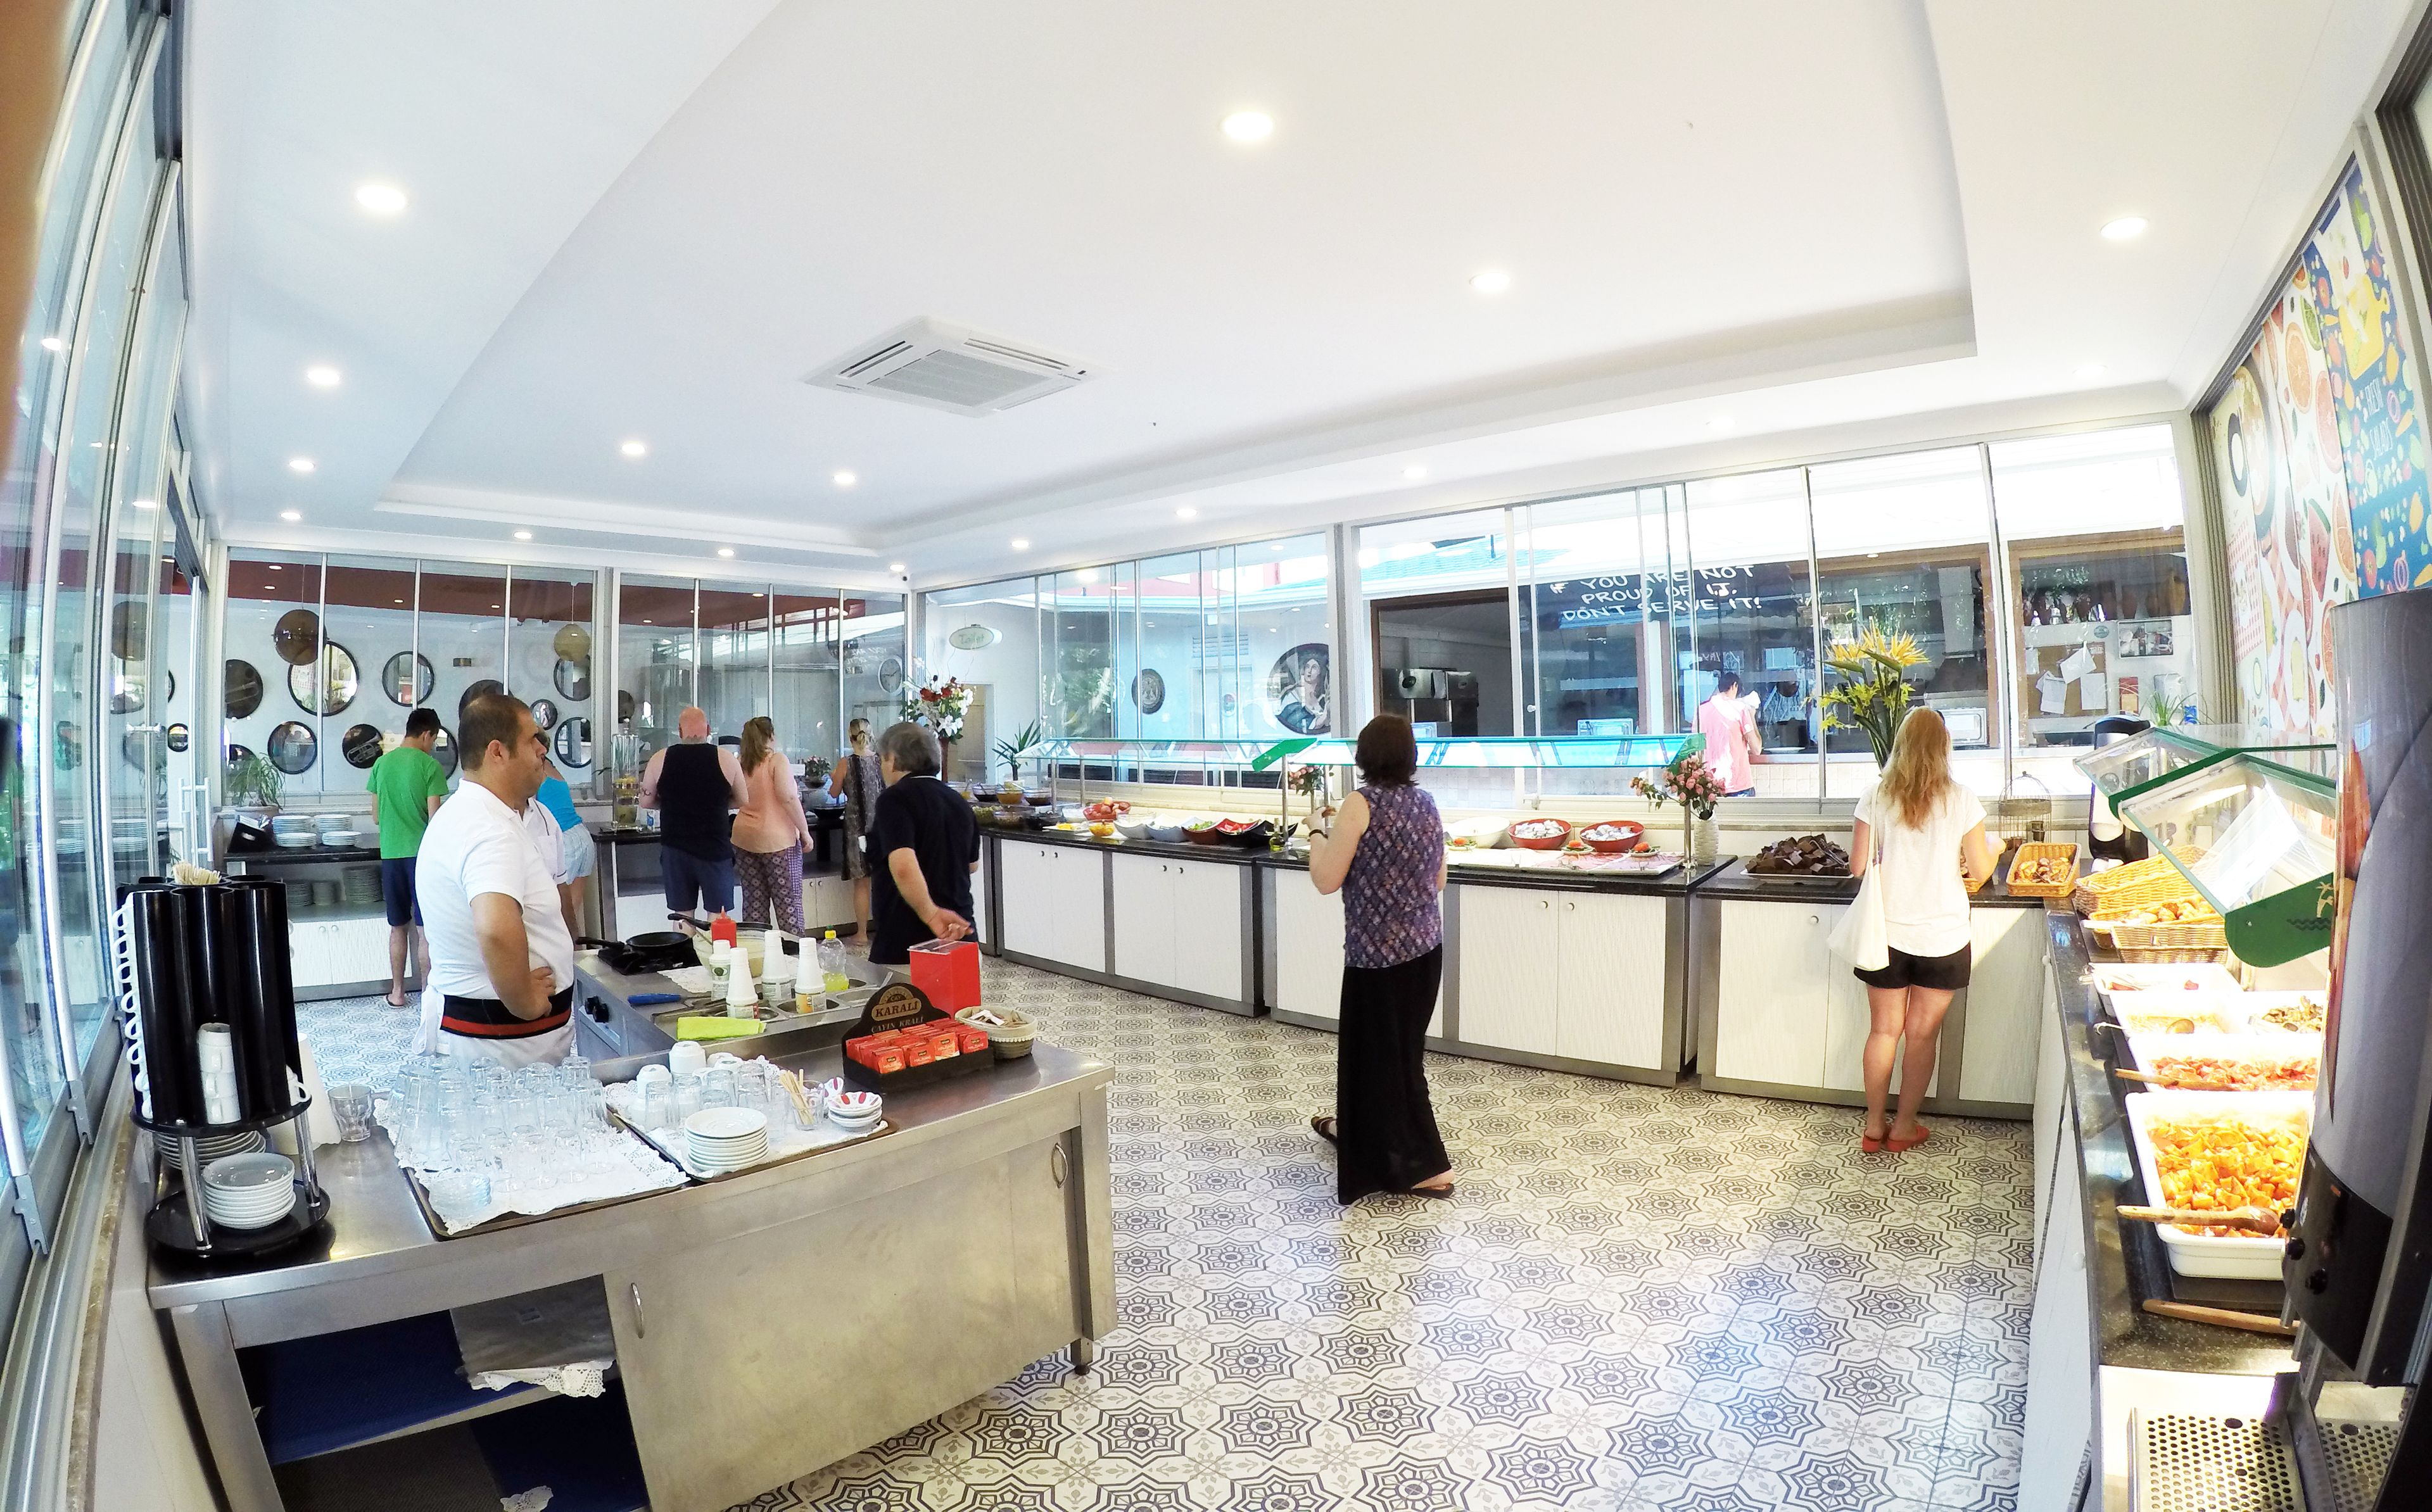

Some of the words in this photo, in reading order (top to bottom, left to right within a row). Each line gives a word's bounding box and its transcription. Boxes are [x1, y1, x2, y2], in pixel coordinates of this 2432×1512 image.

[1580, 575, 1628, 590] YOU
[1645, 570, 1689, 584] ARE
[1699, 565, 1755, 580] NOT
[1581, 588, 1652, 605] PROUD
[1665, 584, 1690, 597] OF
[1562, 605, 1625, 621] DON'T
[1637, 598, 1719, 614] SERVE
[1728, 596, 1763, 610] IT!
